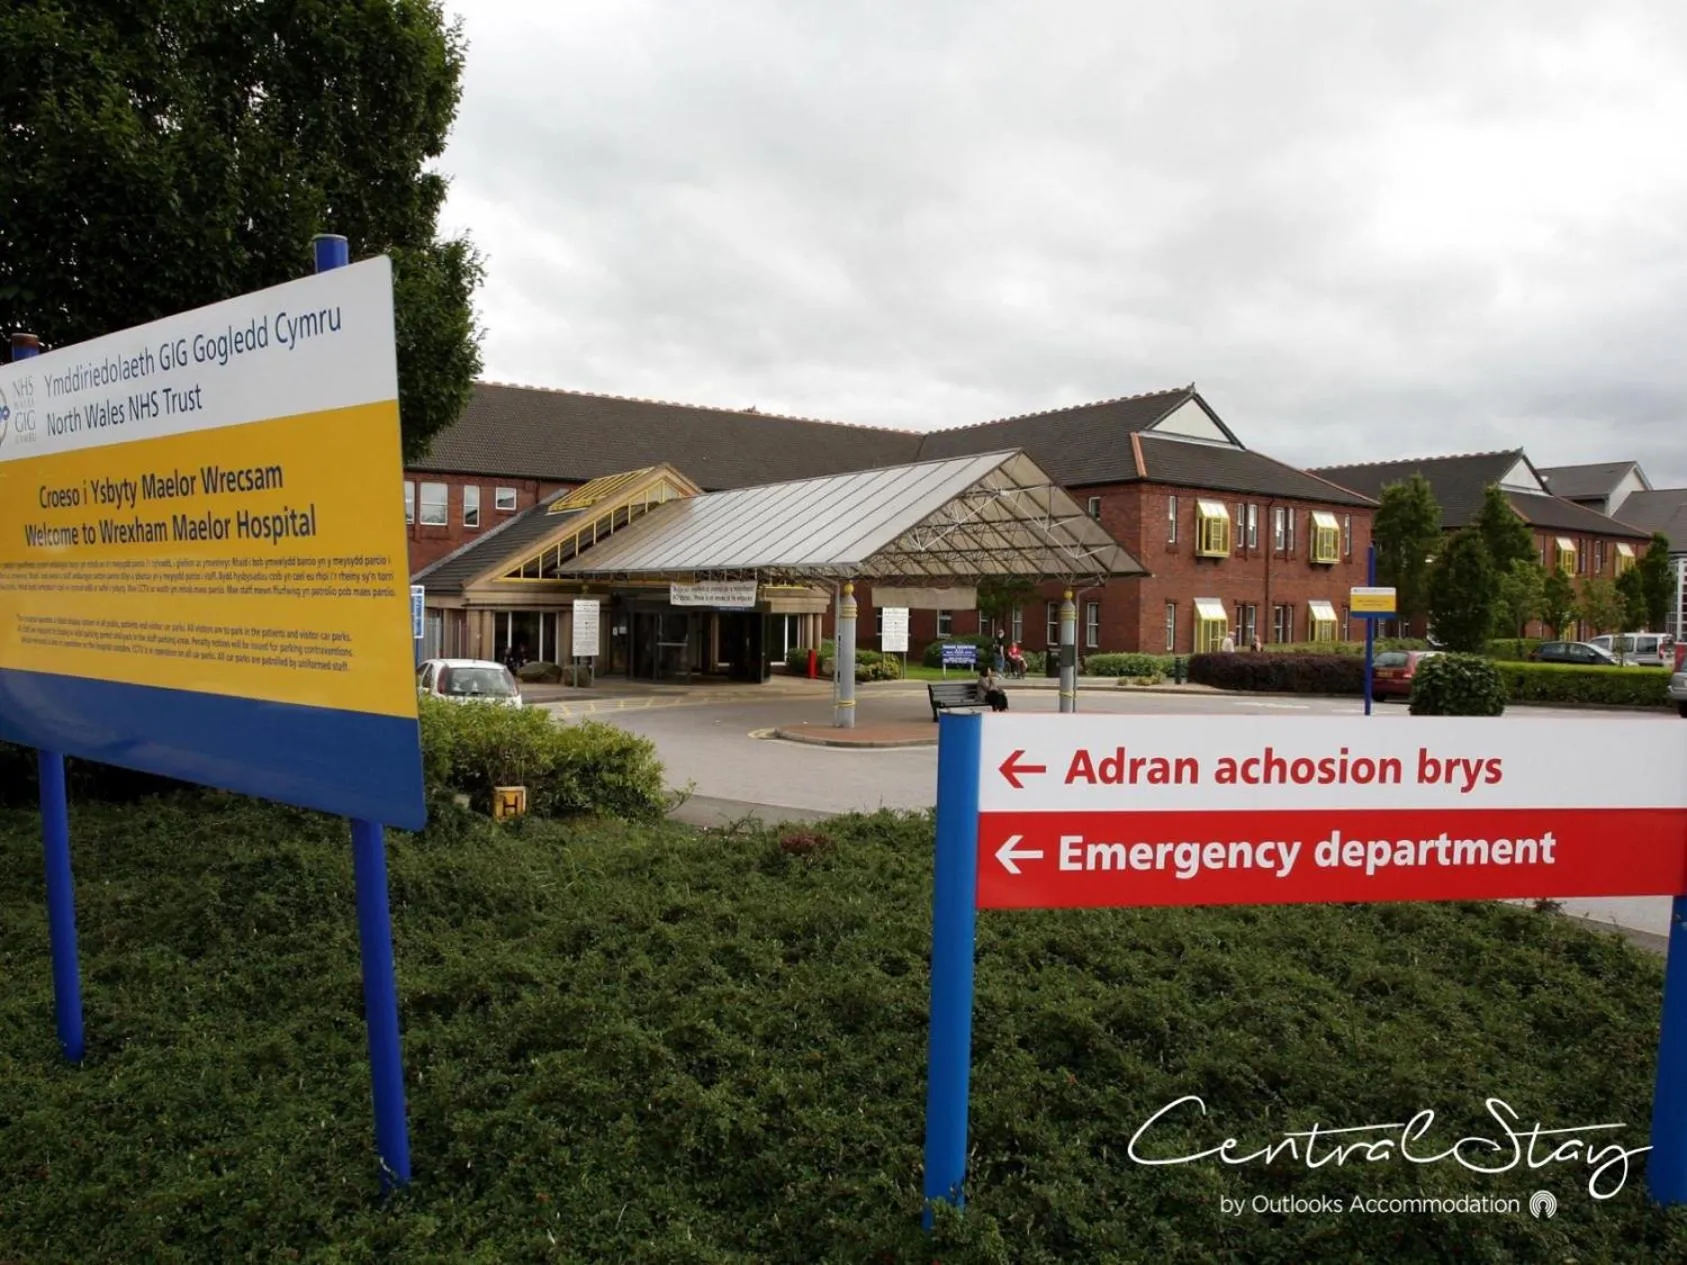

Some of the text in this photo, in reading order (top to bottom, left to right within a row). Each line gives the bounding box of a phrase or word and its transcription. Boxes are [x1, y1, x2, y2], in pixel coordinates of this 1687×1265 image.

[44, 307, 341, 397] Ymddiriedolaeth GIG Gogledd Cymru
[46, 384, 203, 437] North Wales NHS Trust
[39, 465, 283, 510] Croeso i Ysbyty Maelor Wrecsam
[24, 503, 316, 547] Welcome to Wrexham Maelor Hospital
[1066, 748, 1502, 792] Adran achosion brys
[1060, 831, 1557, 879] Emergency department
